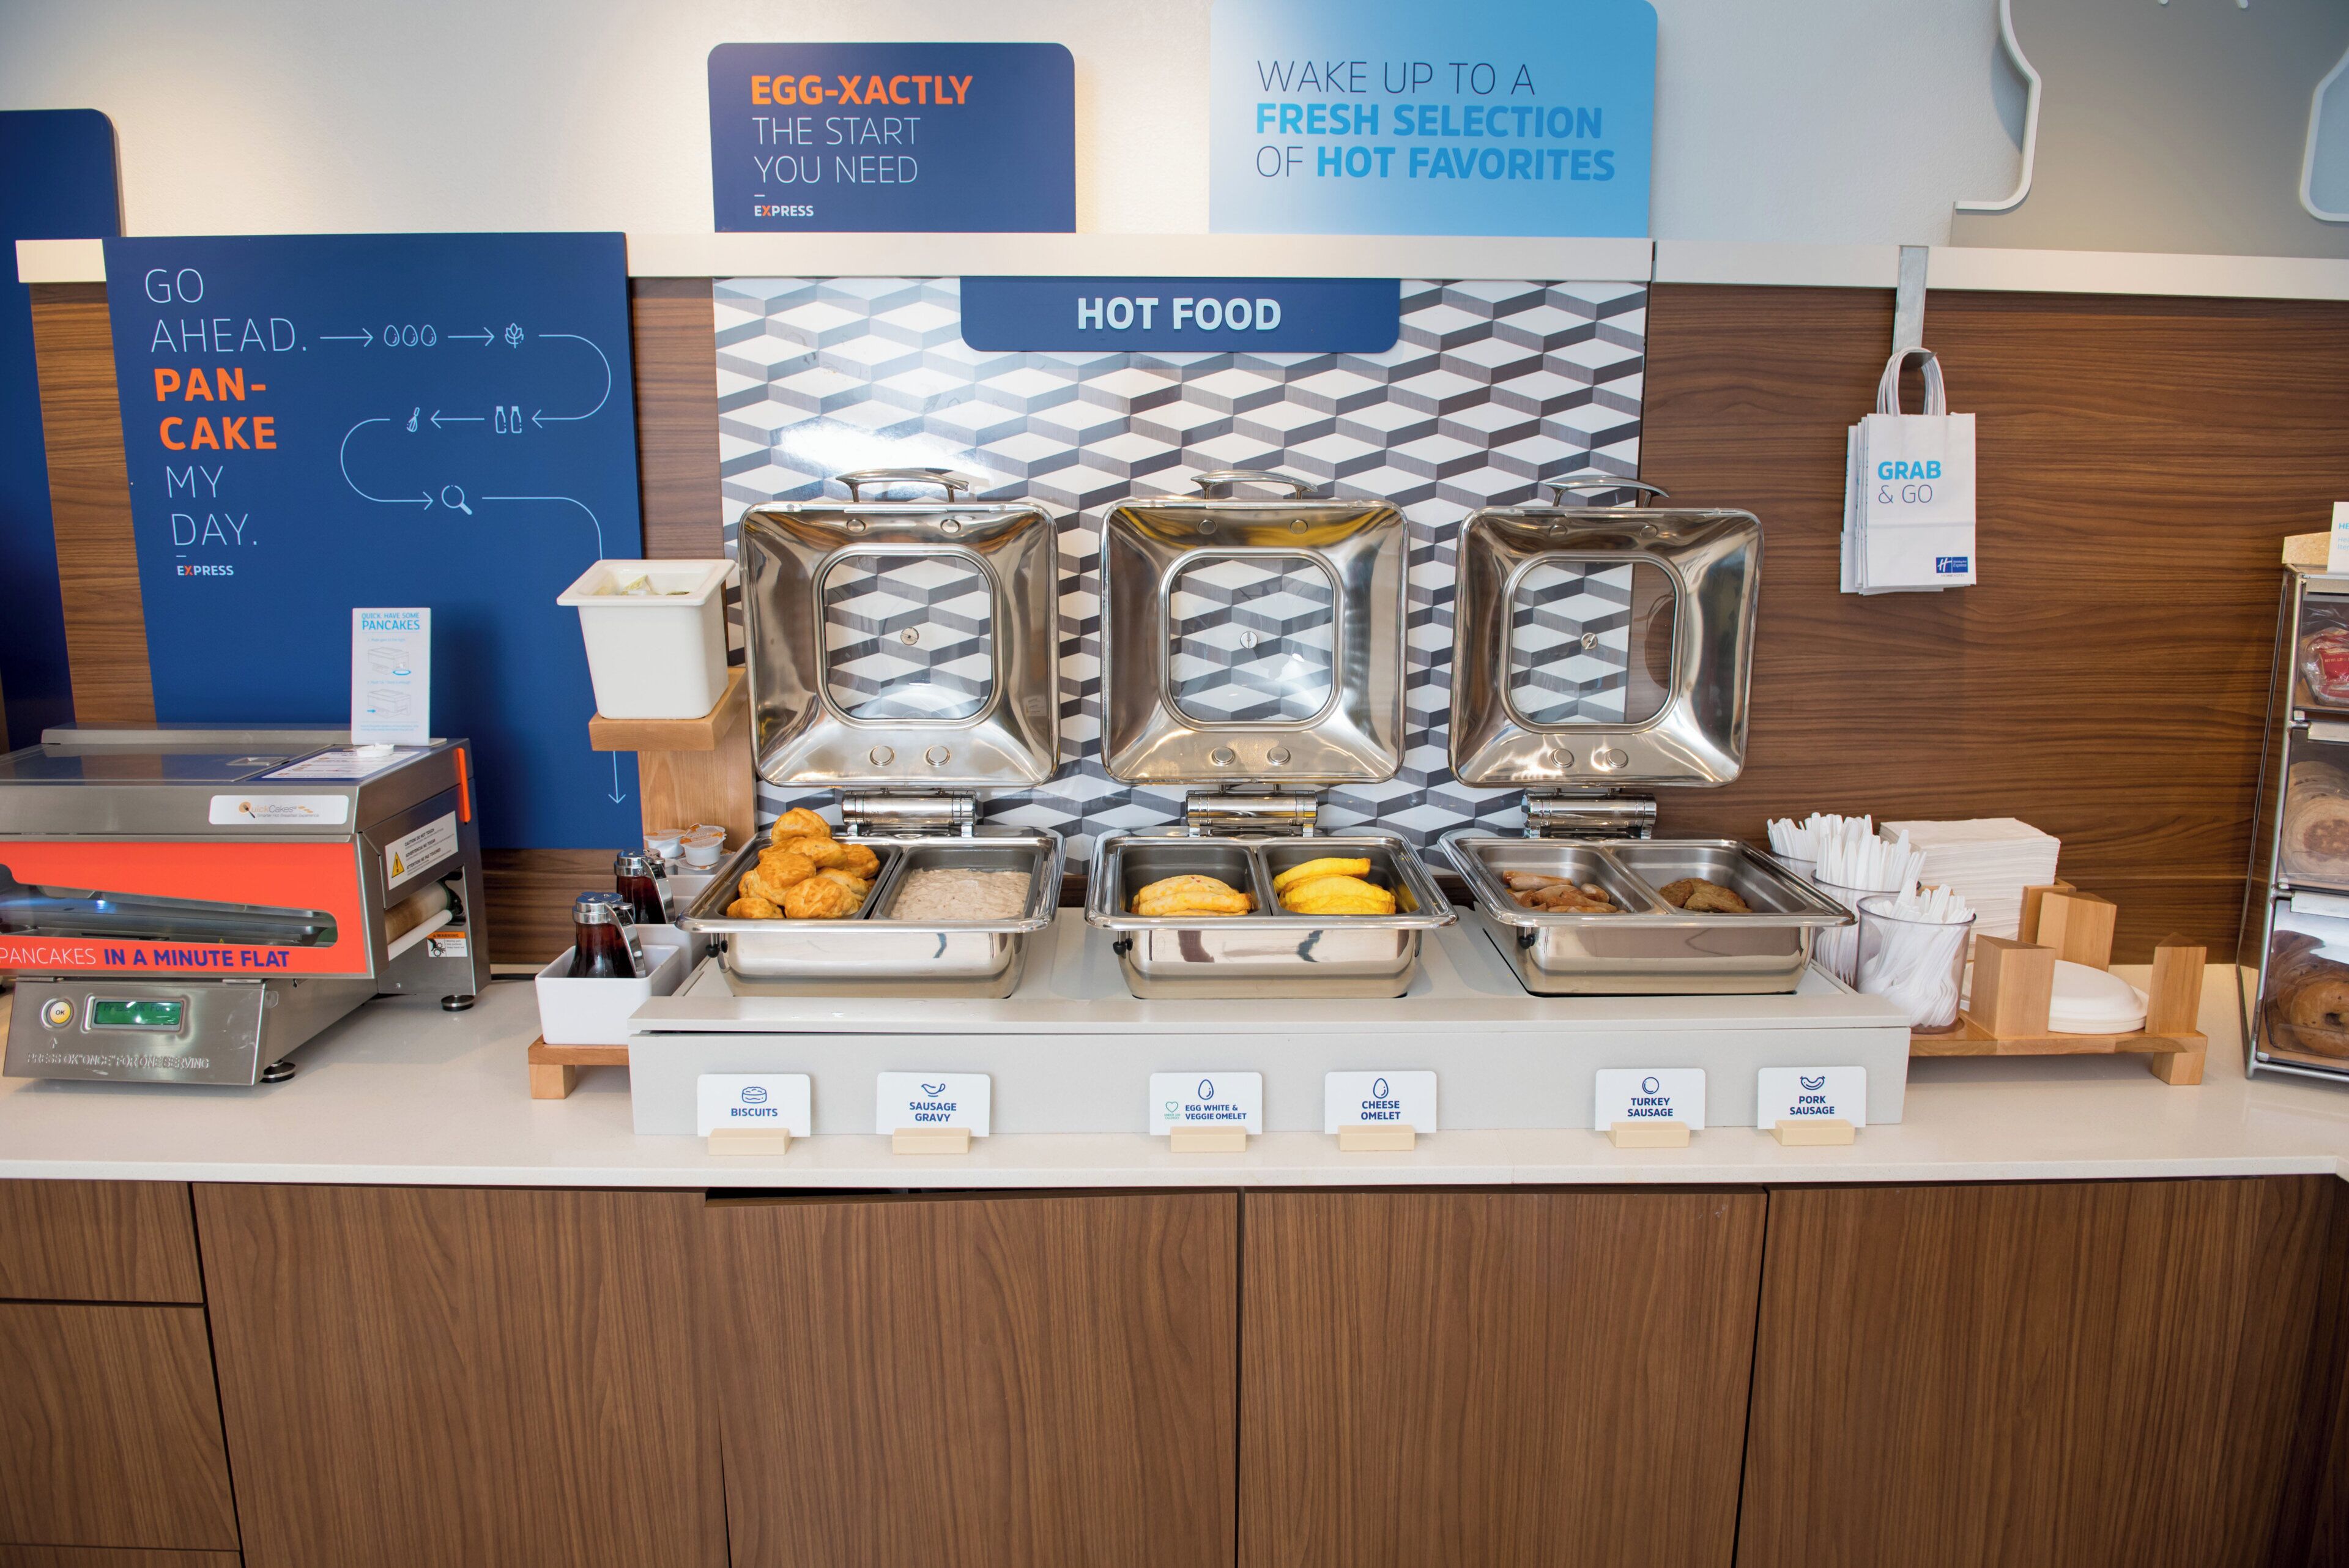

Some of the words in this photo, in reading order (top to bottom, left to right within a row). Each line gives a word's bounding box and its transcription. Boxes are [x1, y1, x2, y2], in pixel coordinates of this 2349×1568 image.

[752, 75, 973, 105] EGG-XACTLY
[1258, 61, 1367, 92] WAKE
[1385, 62, 1433, 94] UP
[1449, 63, 1495, 94] TO
[1511, 64, 1535, 95] A
[752, 117, 812, 144] THE
[826, 117, 920, 144] START
[1257, 103, 1378, 135] FRESH
[1393, 104, 1601, 138] SELECTION
[754, 156, 820, 183] YOU
[836, 156, 917, 183] NEED
[1257, 146, 1303, 177] OF
[1318, 146, 1395, 177] HOT
[1409, 147, 1614, 180] FAVORITES
[755, 206, 814, 216] EXPRESS
[146, 269, 203, 303] GO
[1078, 297, 1159, 329] HOT
[1173, 298, 1281, 330] FOOD
[152, 318, 306, 352] AHEAD.
[154, 368, 265, 401] PAN-
[160, 417, 276, 450] CAKE
[166, 466, 223, 497] MY
[1878, 461, 1941, 480] GRAB
[1879, 485, 1893, 503] &
[1902, 485, 1932, 503] GO
[172, 514, 256, 545] DAY.
[177, 565, 234, 575] EXPRESS
[362, 619, 419, 630] PANCAKES
[0, 948, 95, 964] PANCAKES
[105, 949, 125, 965] IN
[133, 949, 147, 965] A
[154, 949, 234, 967] MINUTE
[240, 951, 289, 967] FLAT
[163, 1057, 209, 1069] SERVING
[910, 1102, 956, 1111] SAUSAGE
[1790, 1106, 1835, 1115] SAUSAGE
